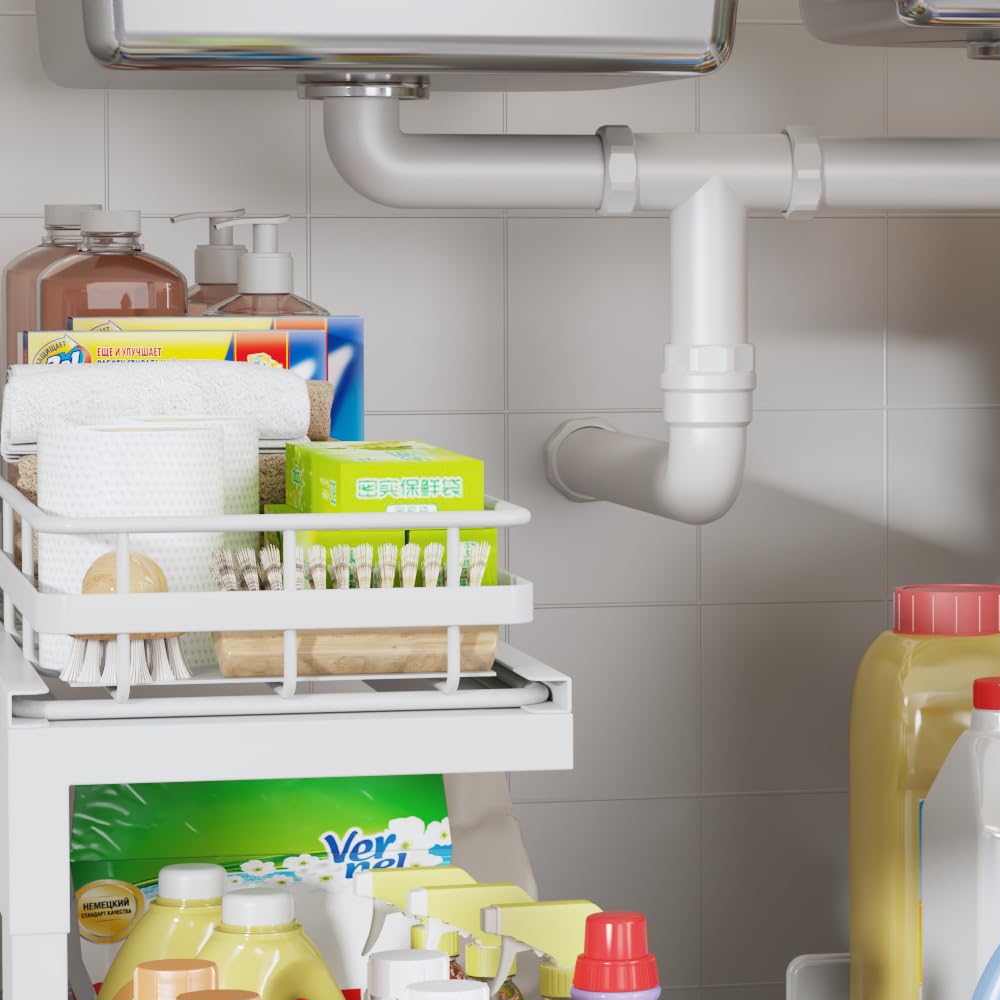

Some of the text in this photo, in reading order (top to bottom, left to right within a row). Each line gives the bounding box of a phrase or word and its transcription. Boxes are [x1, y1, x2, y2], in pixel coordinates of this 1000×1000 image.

[97, 347, 162, 358] ЕЩЕ И УЛУЧШАЕТ
[324, 830, 397, 864] Ver
[83, 897, 130, 911] НЕМЕЦКИЙ
